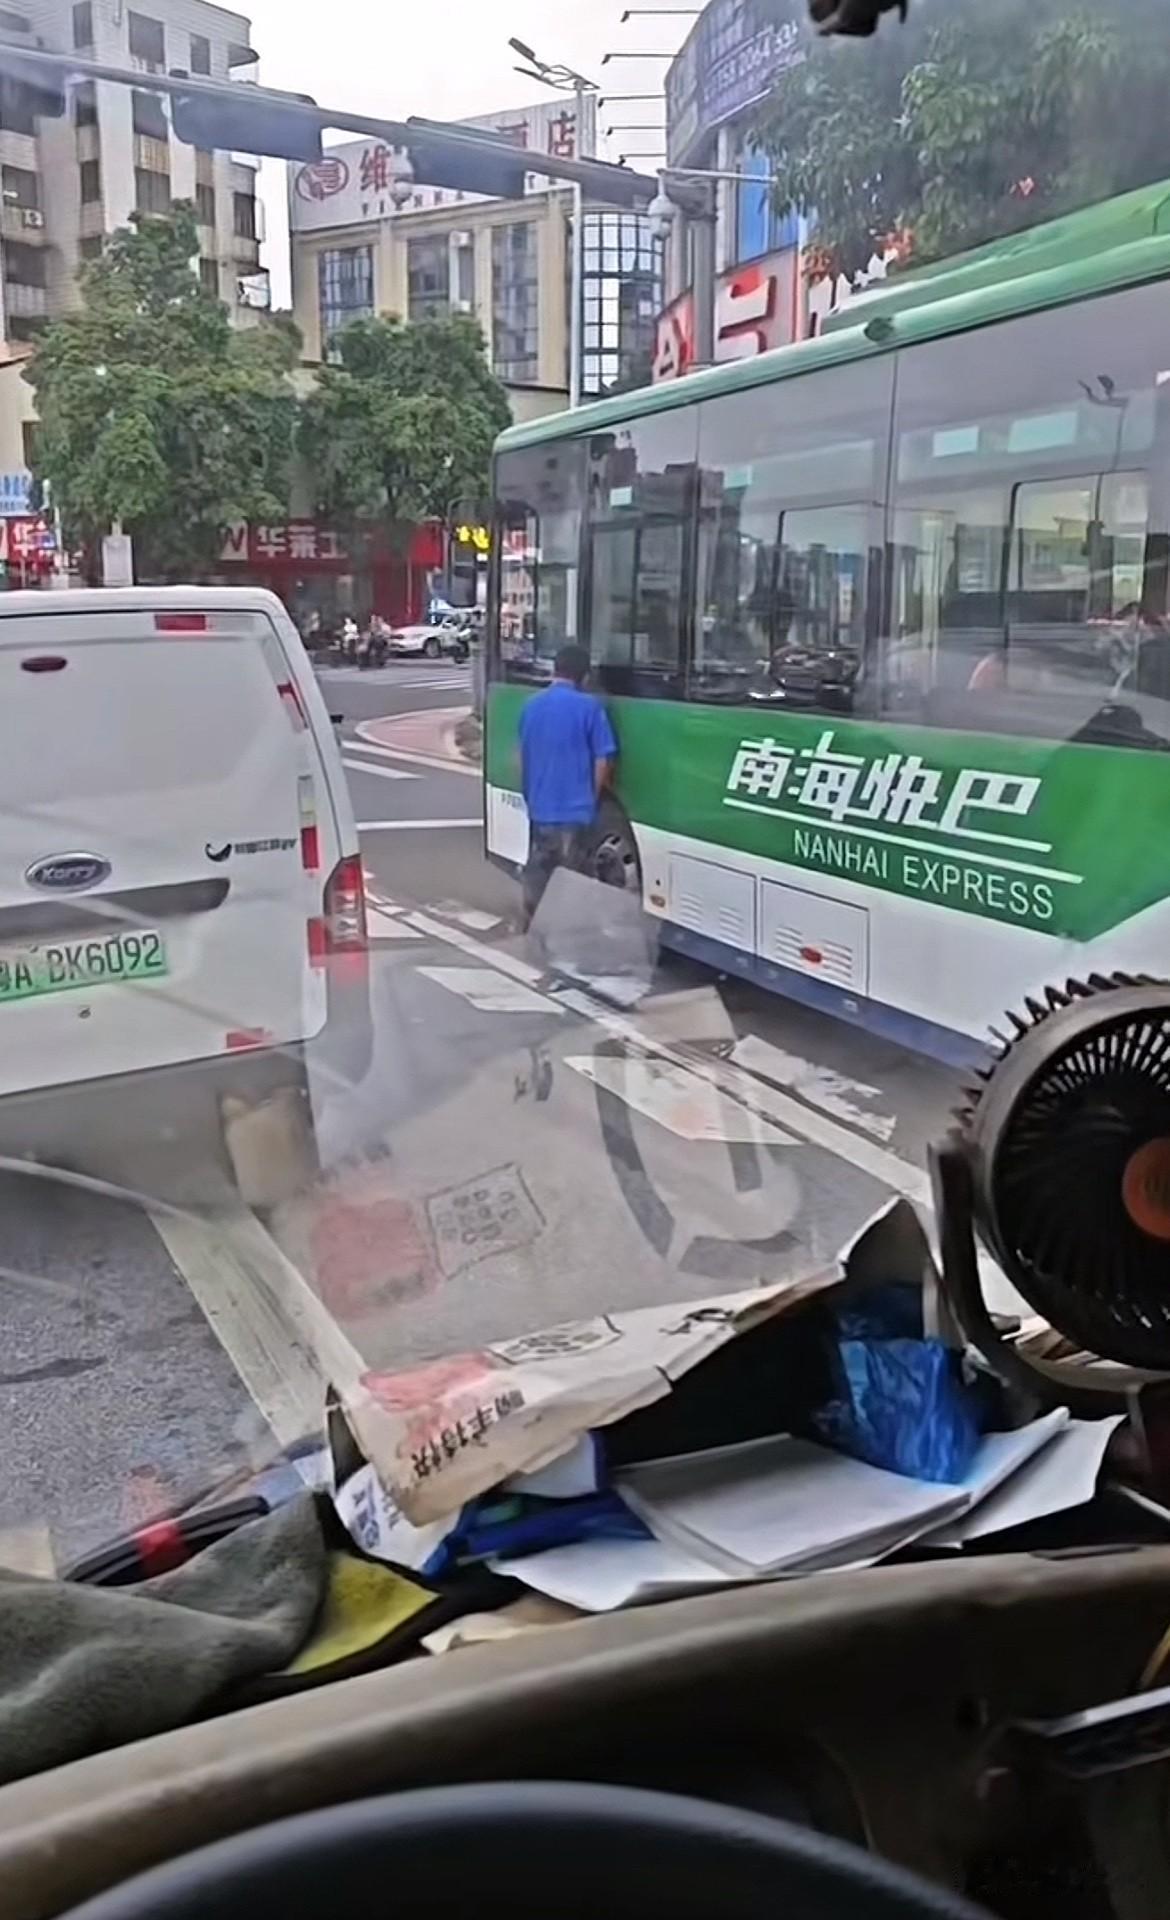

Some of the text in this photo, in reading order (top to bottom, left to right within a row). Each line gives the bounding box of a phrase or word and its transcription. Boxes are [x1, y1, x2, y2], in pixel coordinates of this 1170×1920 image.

[727, 731, 1052, 852] 南海快巴
[793, 829, 1054, 919] NANHAI EXPRESS
